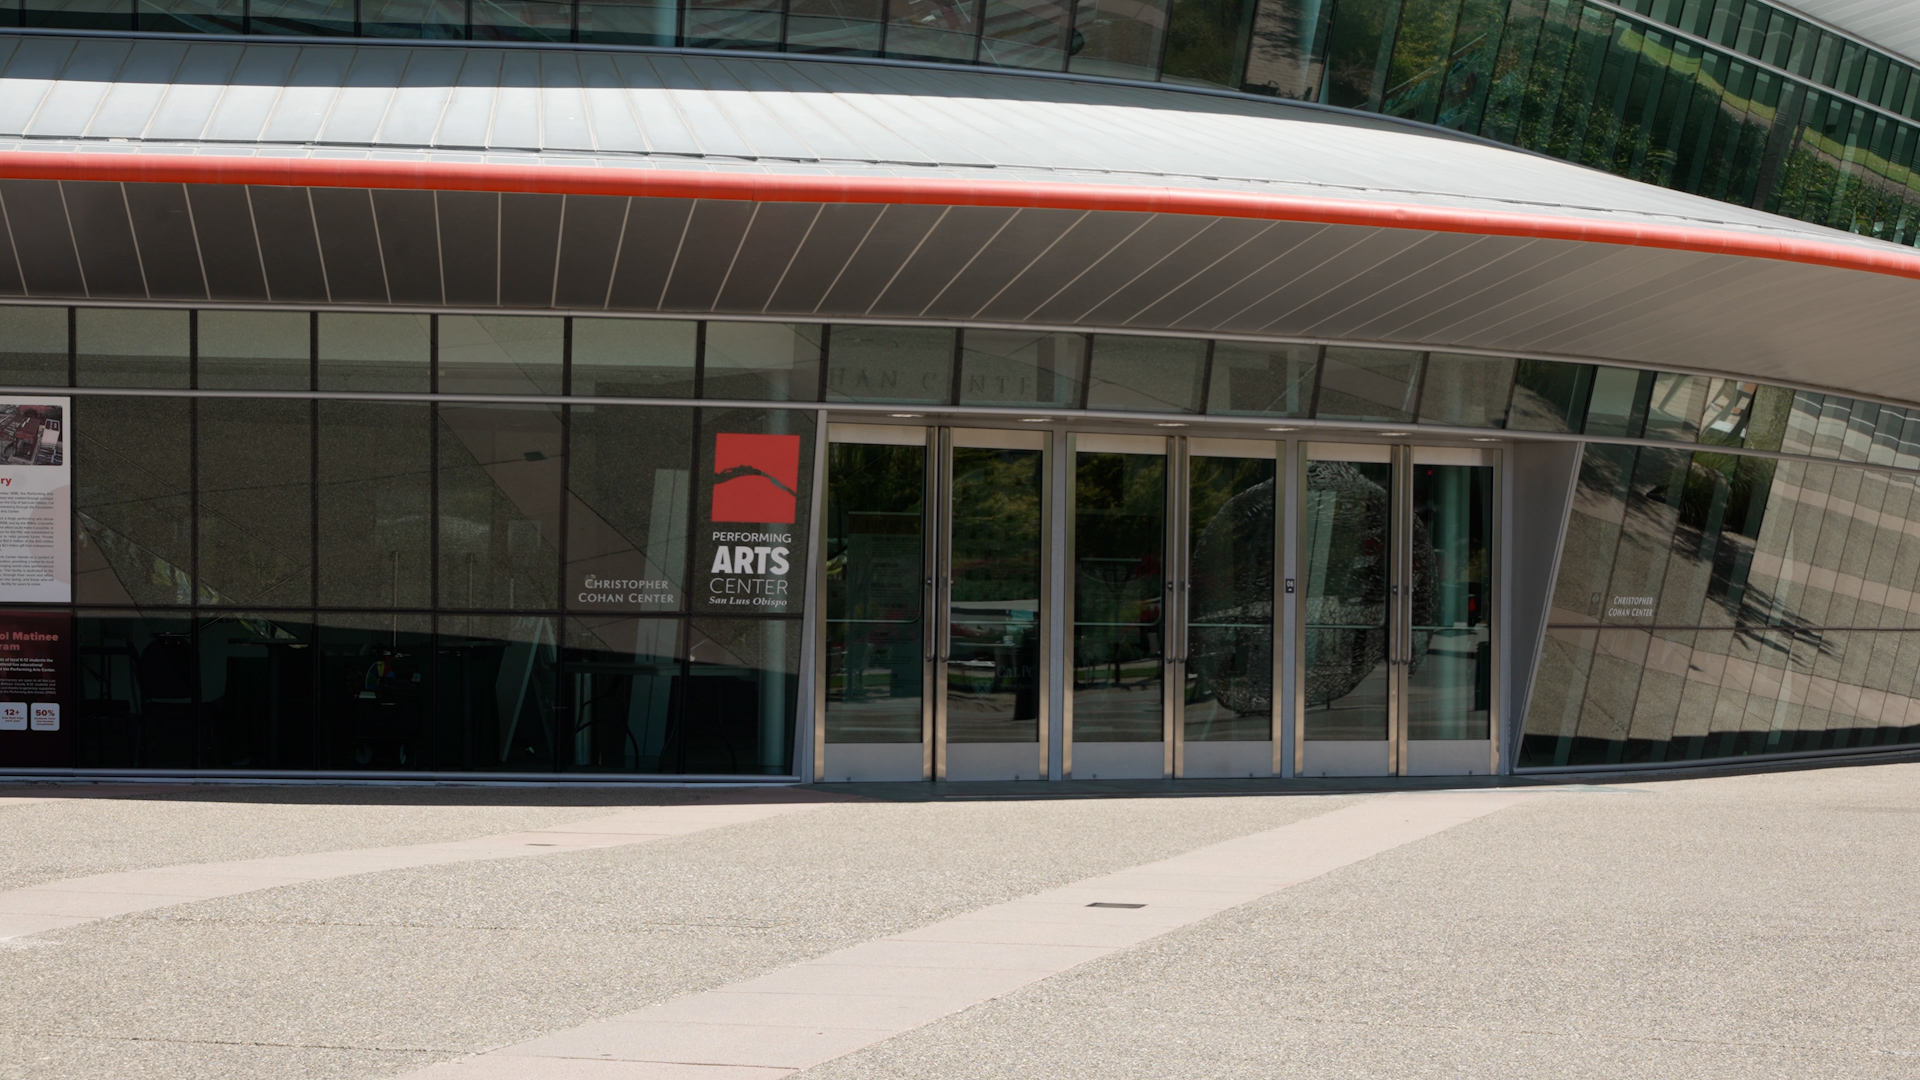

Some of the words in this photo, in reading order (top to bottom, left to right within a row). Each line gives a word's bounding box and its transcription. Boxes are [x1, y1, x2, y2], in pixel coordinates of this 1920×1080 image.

[712, 532, 791, 543] PERFORMING
[711, 545, 790, 575] ARTS
[584, 579, 668, 589] CHRISTOPHER
[710, 578, 788, 595] CENTER
[578, 593, 624, 602] COHAN
[629, 593, 674, 603] CENTER
[709, 596, 727, 604] San
[729, 596, 750, 605] Luis
[752, 597, 787, 608] Obispo
[1614, 596, 1653, 605] CHRISTOPHER
[1608, 608, 1630, 616] COHAN
[1631, 608, 1653, 616] CENTER
[13, 632, 58, 641] Matinee
